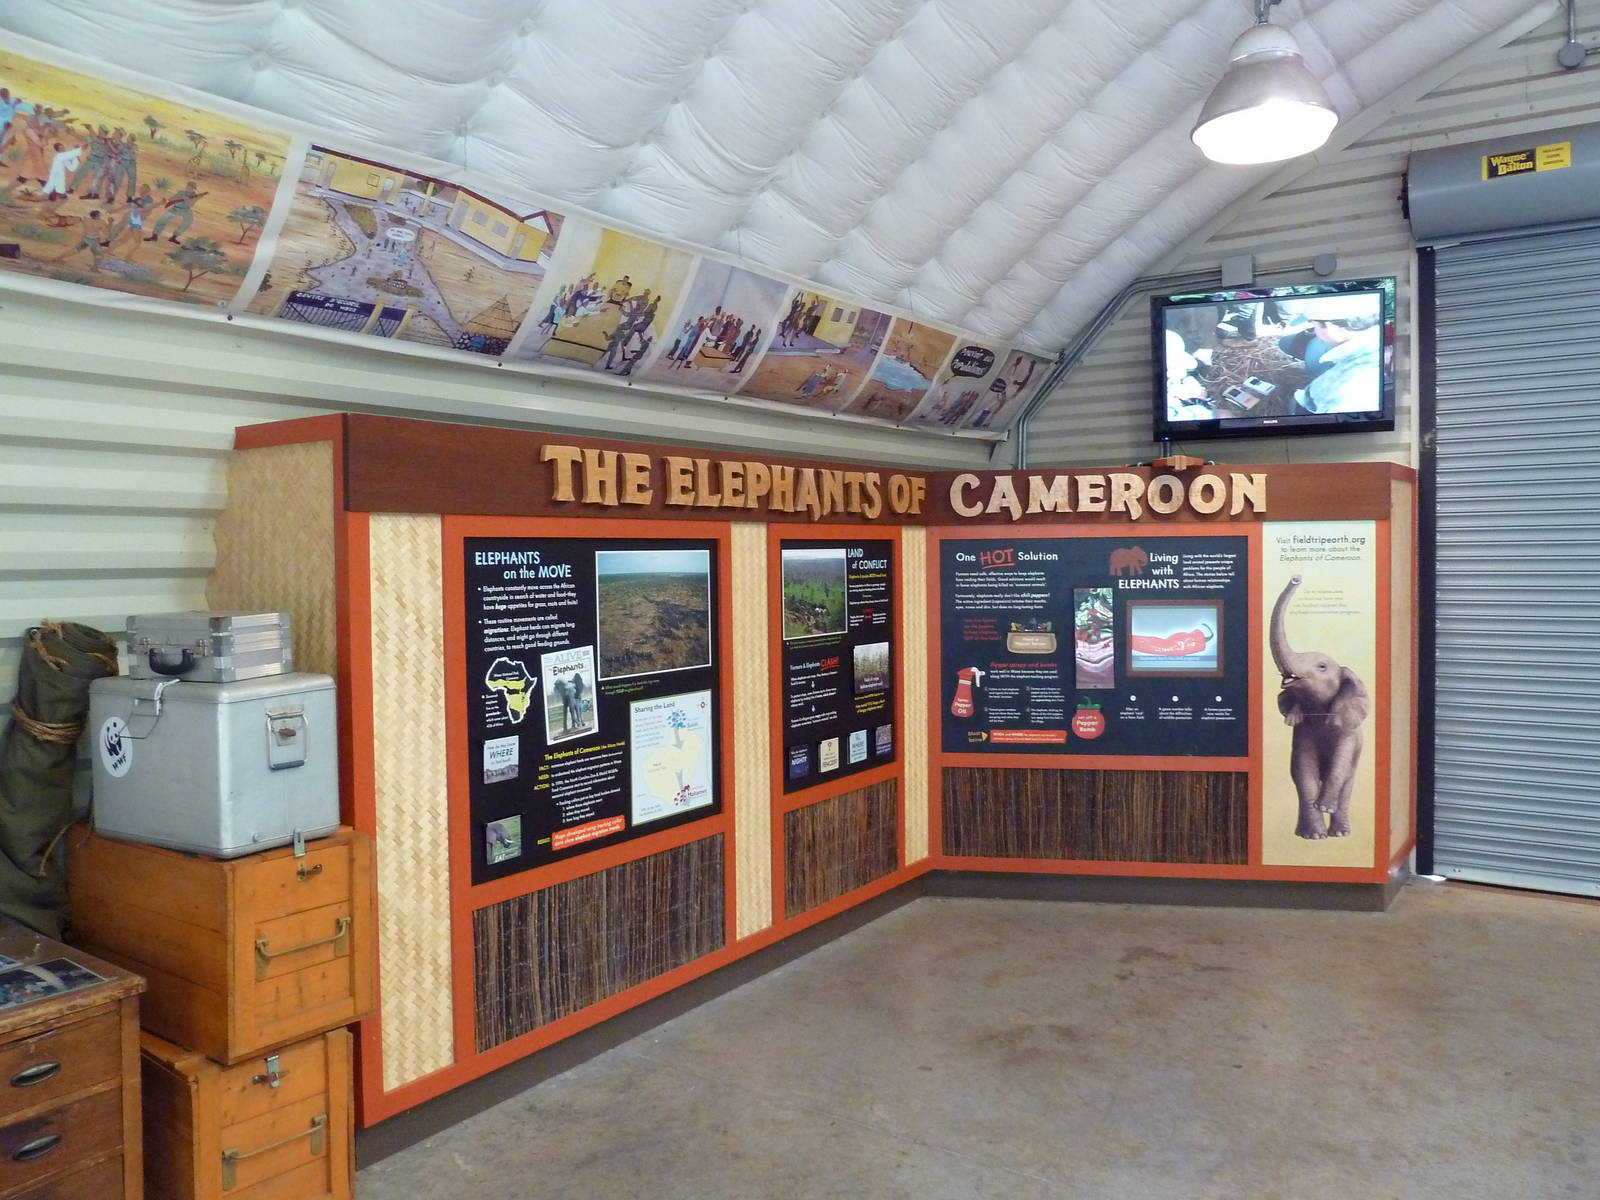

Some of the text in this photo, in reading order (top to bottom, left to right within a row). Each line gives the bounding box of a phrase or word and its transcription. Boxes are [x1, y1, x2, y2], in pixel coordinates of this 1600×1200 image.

[1490, 153, 1527, 167] Wayne
[1498, 161, 1533, 175] Dalton
[540, 444, 1268, 521] THE ELEPHANTS OF CAMEROON
[1276, 534, 1366, 547] Visit fieldtripearth.org
[847, 548, 864, 558] LAND
[1289, 545, 1308, 553] learn
[1349, 545, 1361, 553] the
[475, 551, 541, 566] ELEPHANTS
[956, 548, 1059, 566] One HOT Solution
[1149, 552, 1179, 565] Living
[1279, 554, 1313, 564] Elephants
[503, 563, 572, 579] on the MOVE
[852, 559, 888, 570] of CONFLICT
[1152, 565, 1174, 576] with
[1118, 578, 1180, 589] ELEPHANTS
[552, 662, 584, 676] Elephants
[634, 702, 676, 714] Sharing the Land
[489, 747, 514, 760] WHERE
[112, 752, 128, 771] WWF
